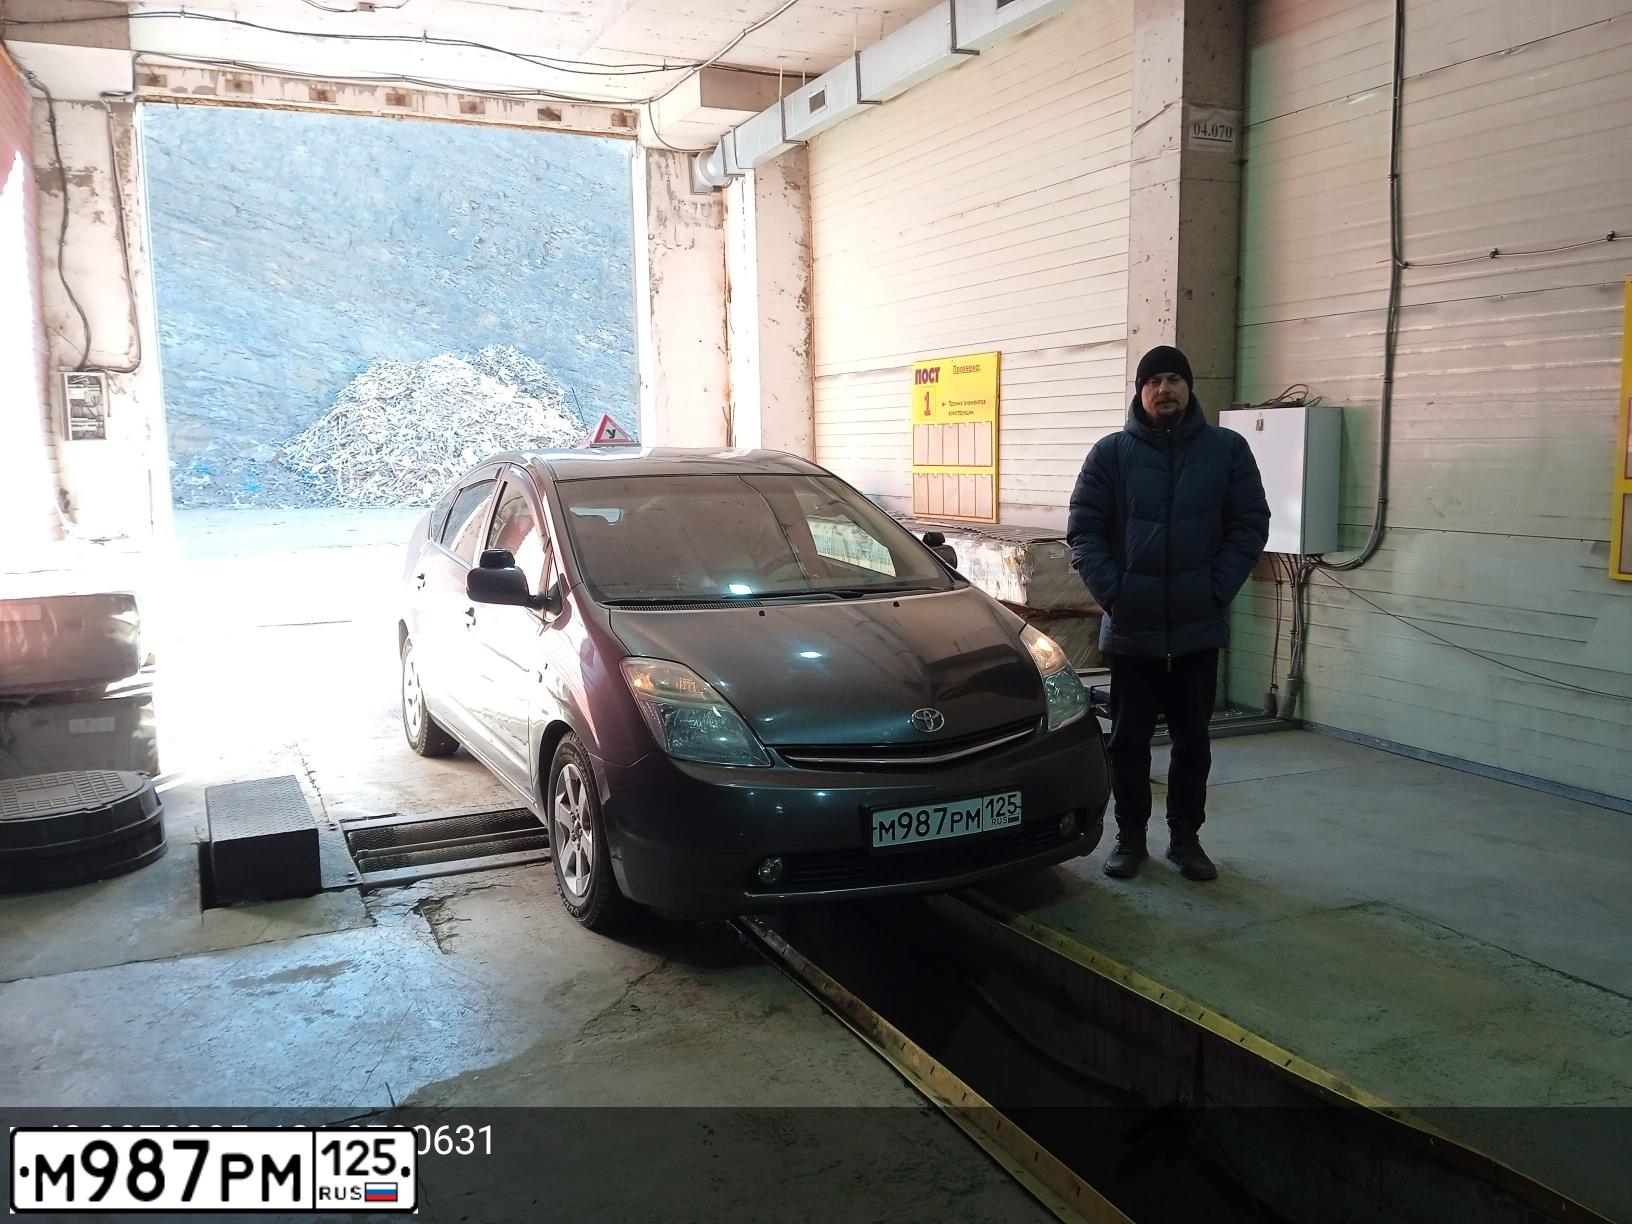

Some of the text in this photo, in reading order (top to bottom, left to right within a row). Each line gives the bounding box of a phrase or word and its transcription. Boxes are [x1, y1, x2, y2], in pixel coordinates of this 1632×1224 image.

[1193, 122, 1233, 139] 04.070
[914, 366, 941, 385] ПОСТ
[924, 391, 931, 417] 1
[878, 793, 1018, 842] М987РМ 125
[991, 815, 1008, 826] RUS
